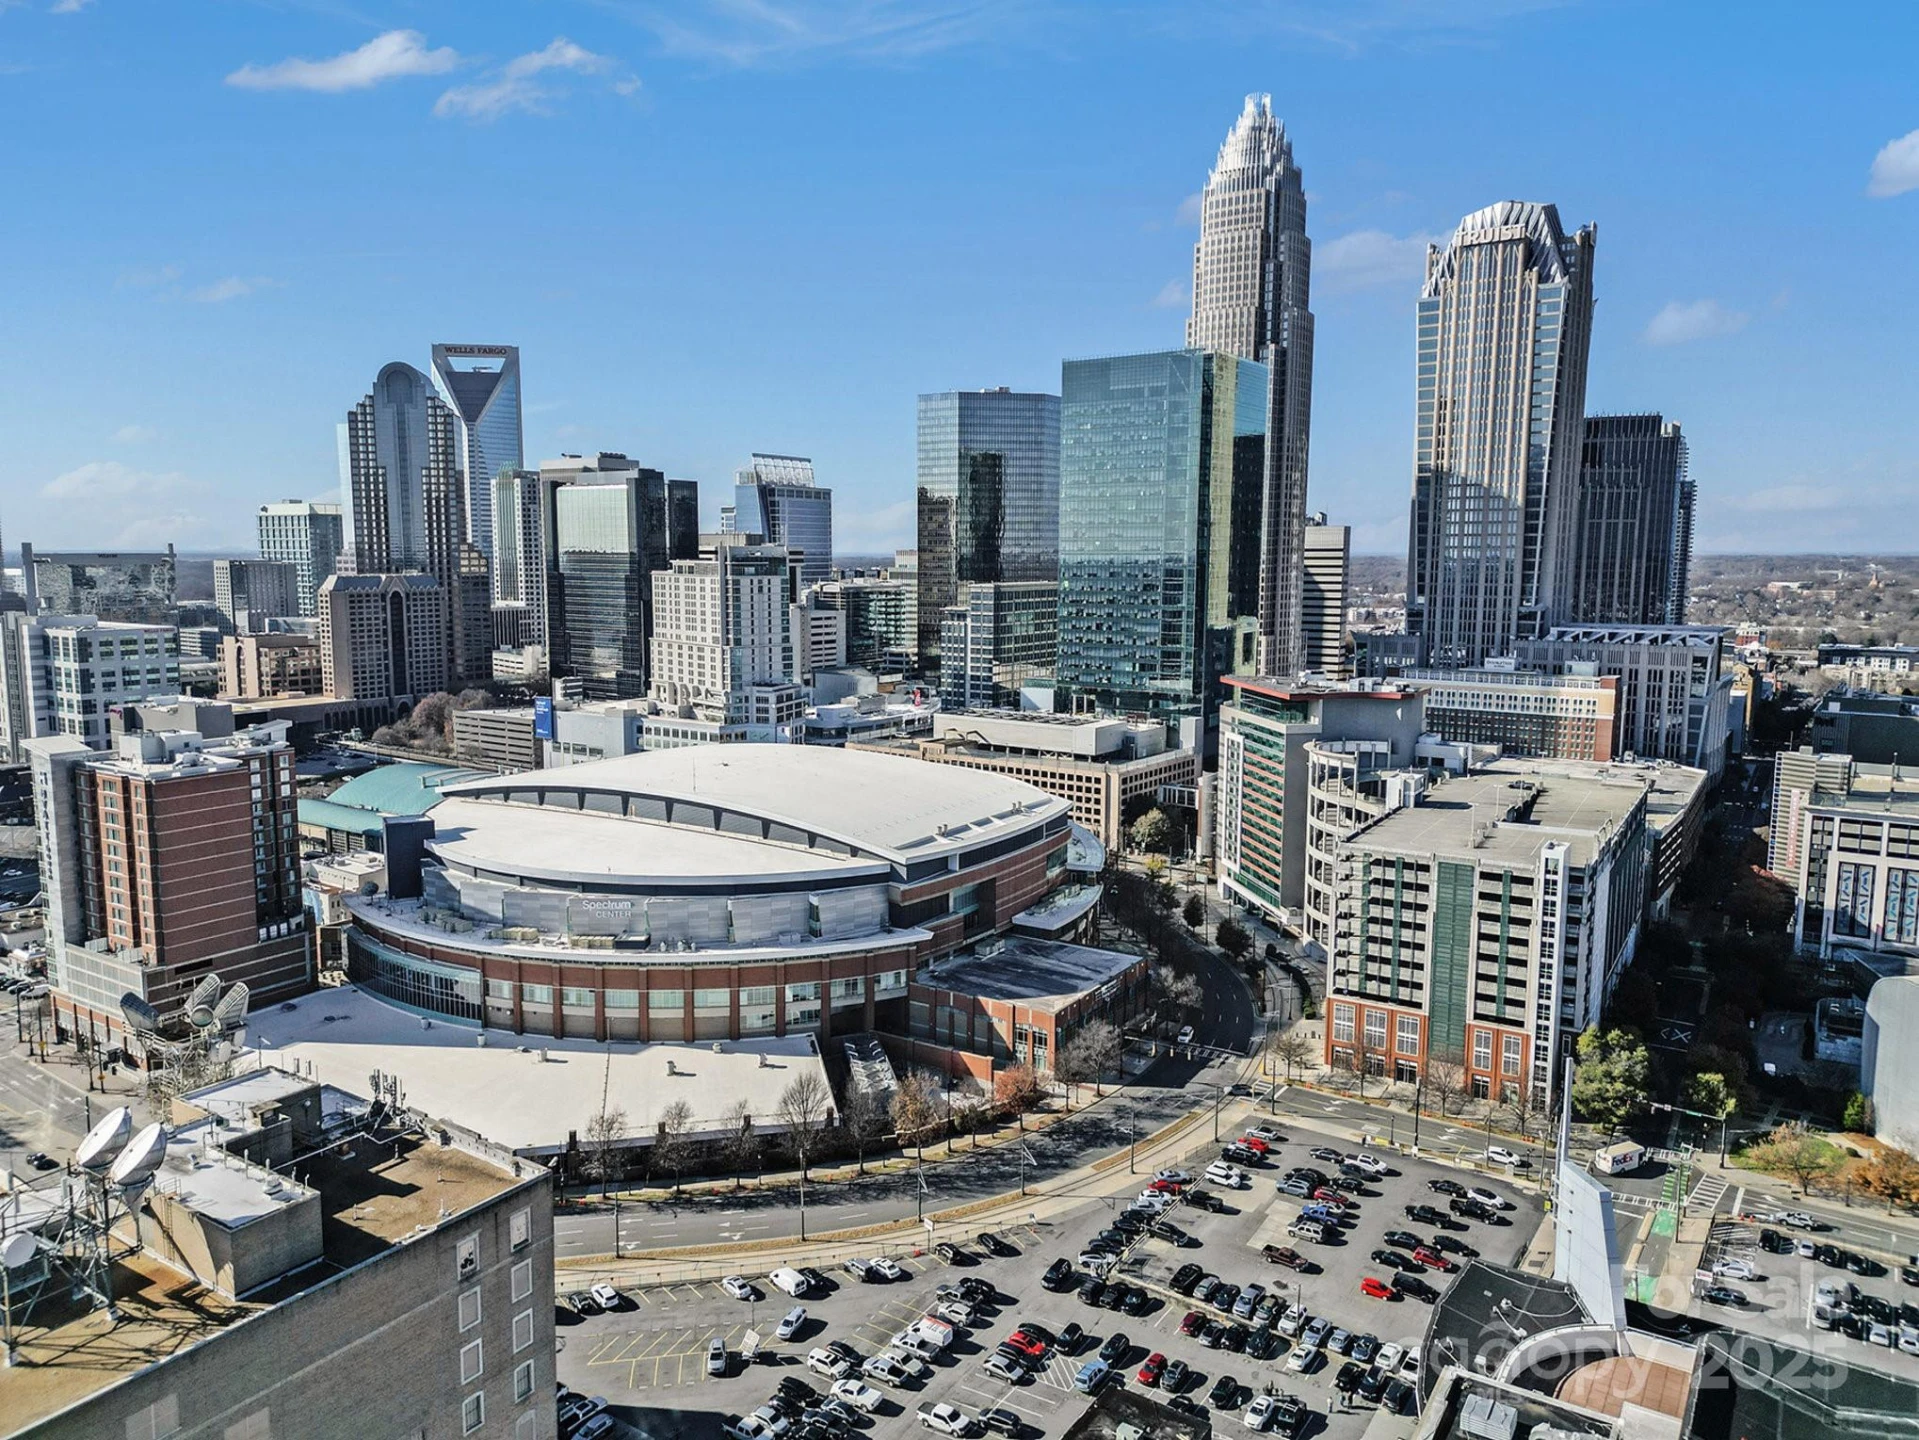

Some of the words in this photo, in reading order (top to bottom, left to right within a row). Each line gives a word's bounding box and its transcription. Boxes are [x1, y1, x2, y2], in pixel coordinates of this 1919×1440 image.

[1455, 224, 1526, 247] TRUIST
[444, 346, 475, 354] WELLS
[477, 347, 507, 355] FARGO
[582, 900, 632, 912] Spectrum
[595, 910, 632, 919] CENTER
[1611, 1153, 1633, 1167] FedEx
